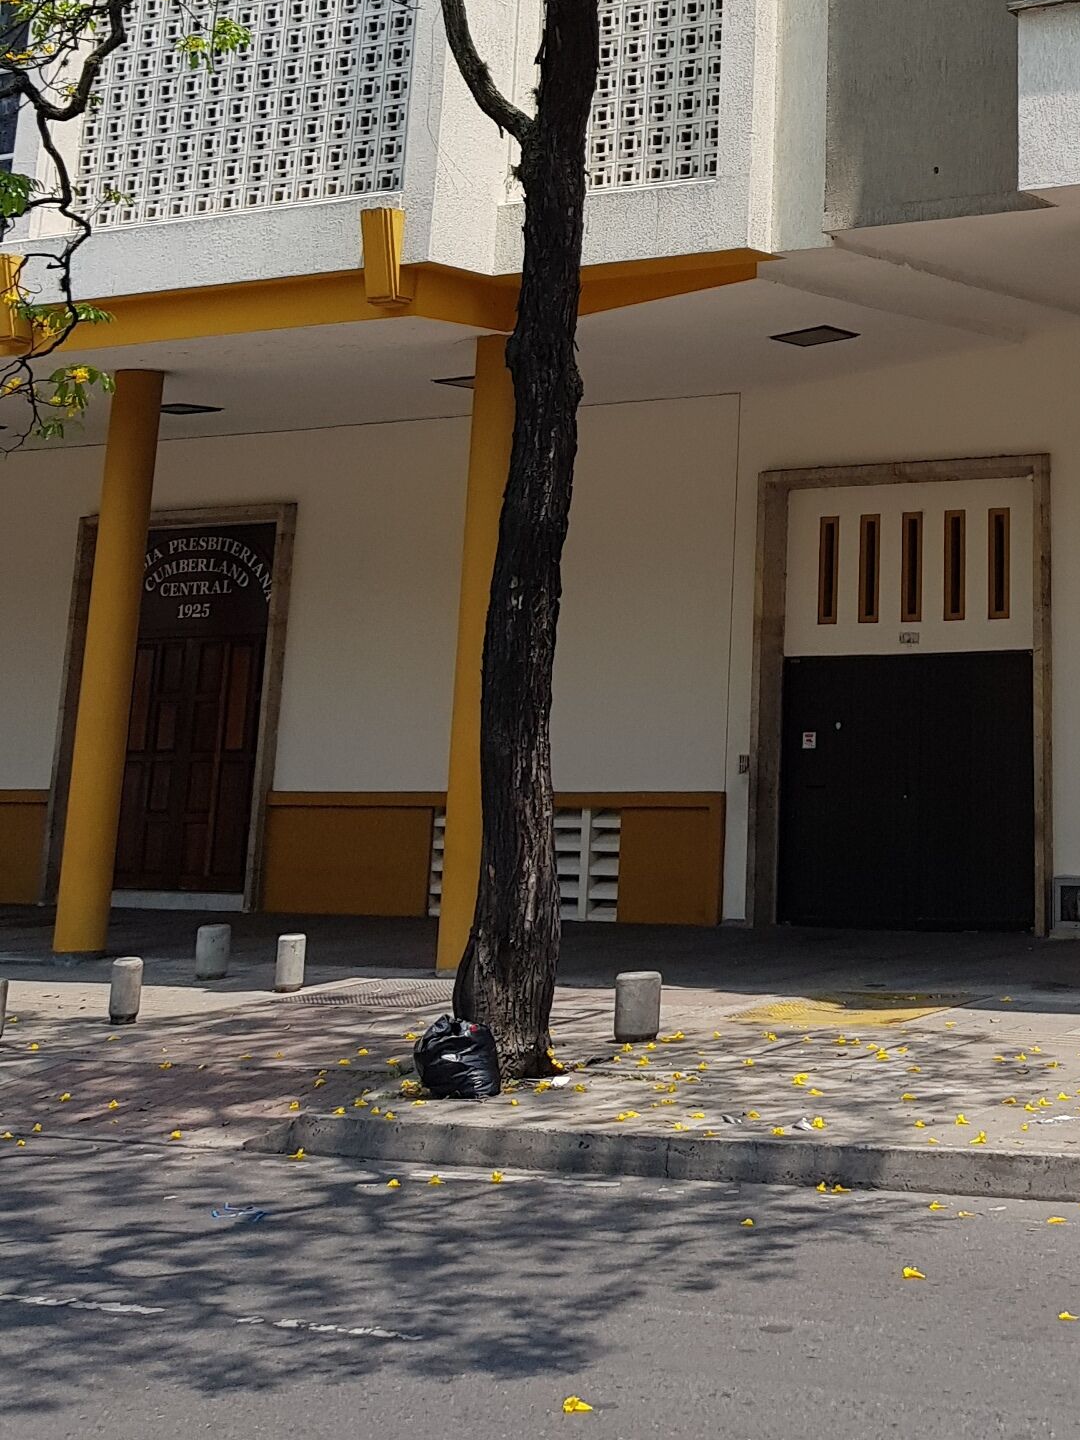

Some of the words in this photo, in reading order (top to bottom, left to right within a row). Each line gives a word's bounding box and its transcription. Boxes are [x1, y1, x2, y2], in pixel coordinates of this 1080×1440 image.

[144, 558, 249, 592] CUMBERLAND
[168, 536, 272, 603] PRESBITERIANA
[160, 580, 233, 597] CENTRAL
[177, 602, 211, 619] 1925
